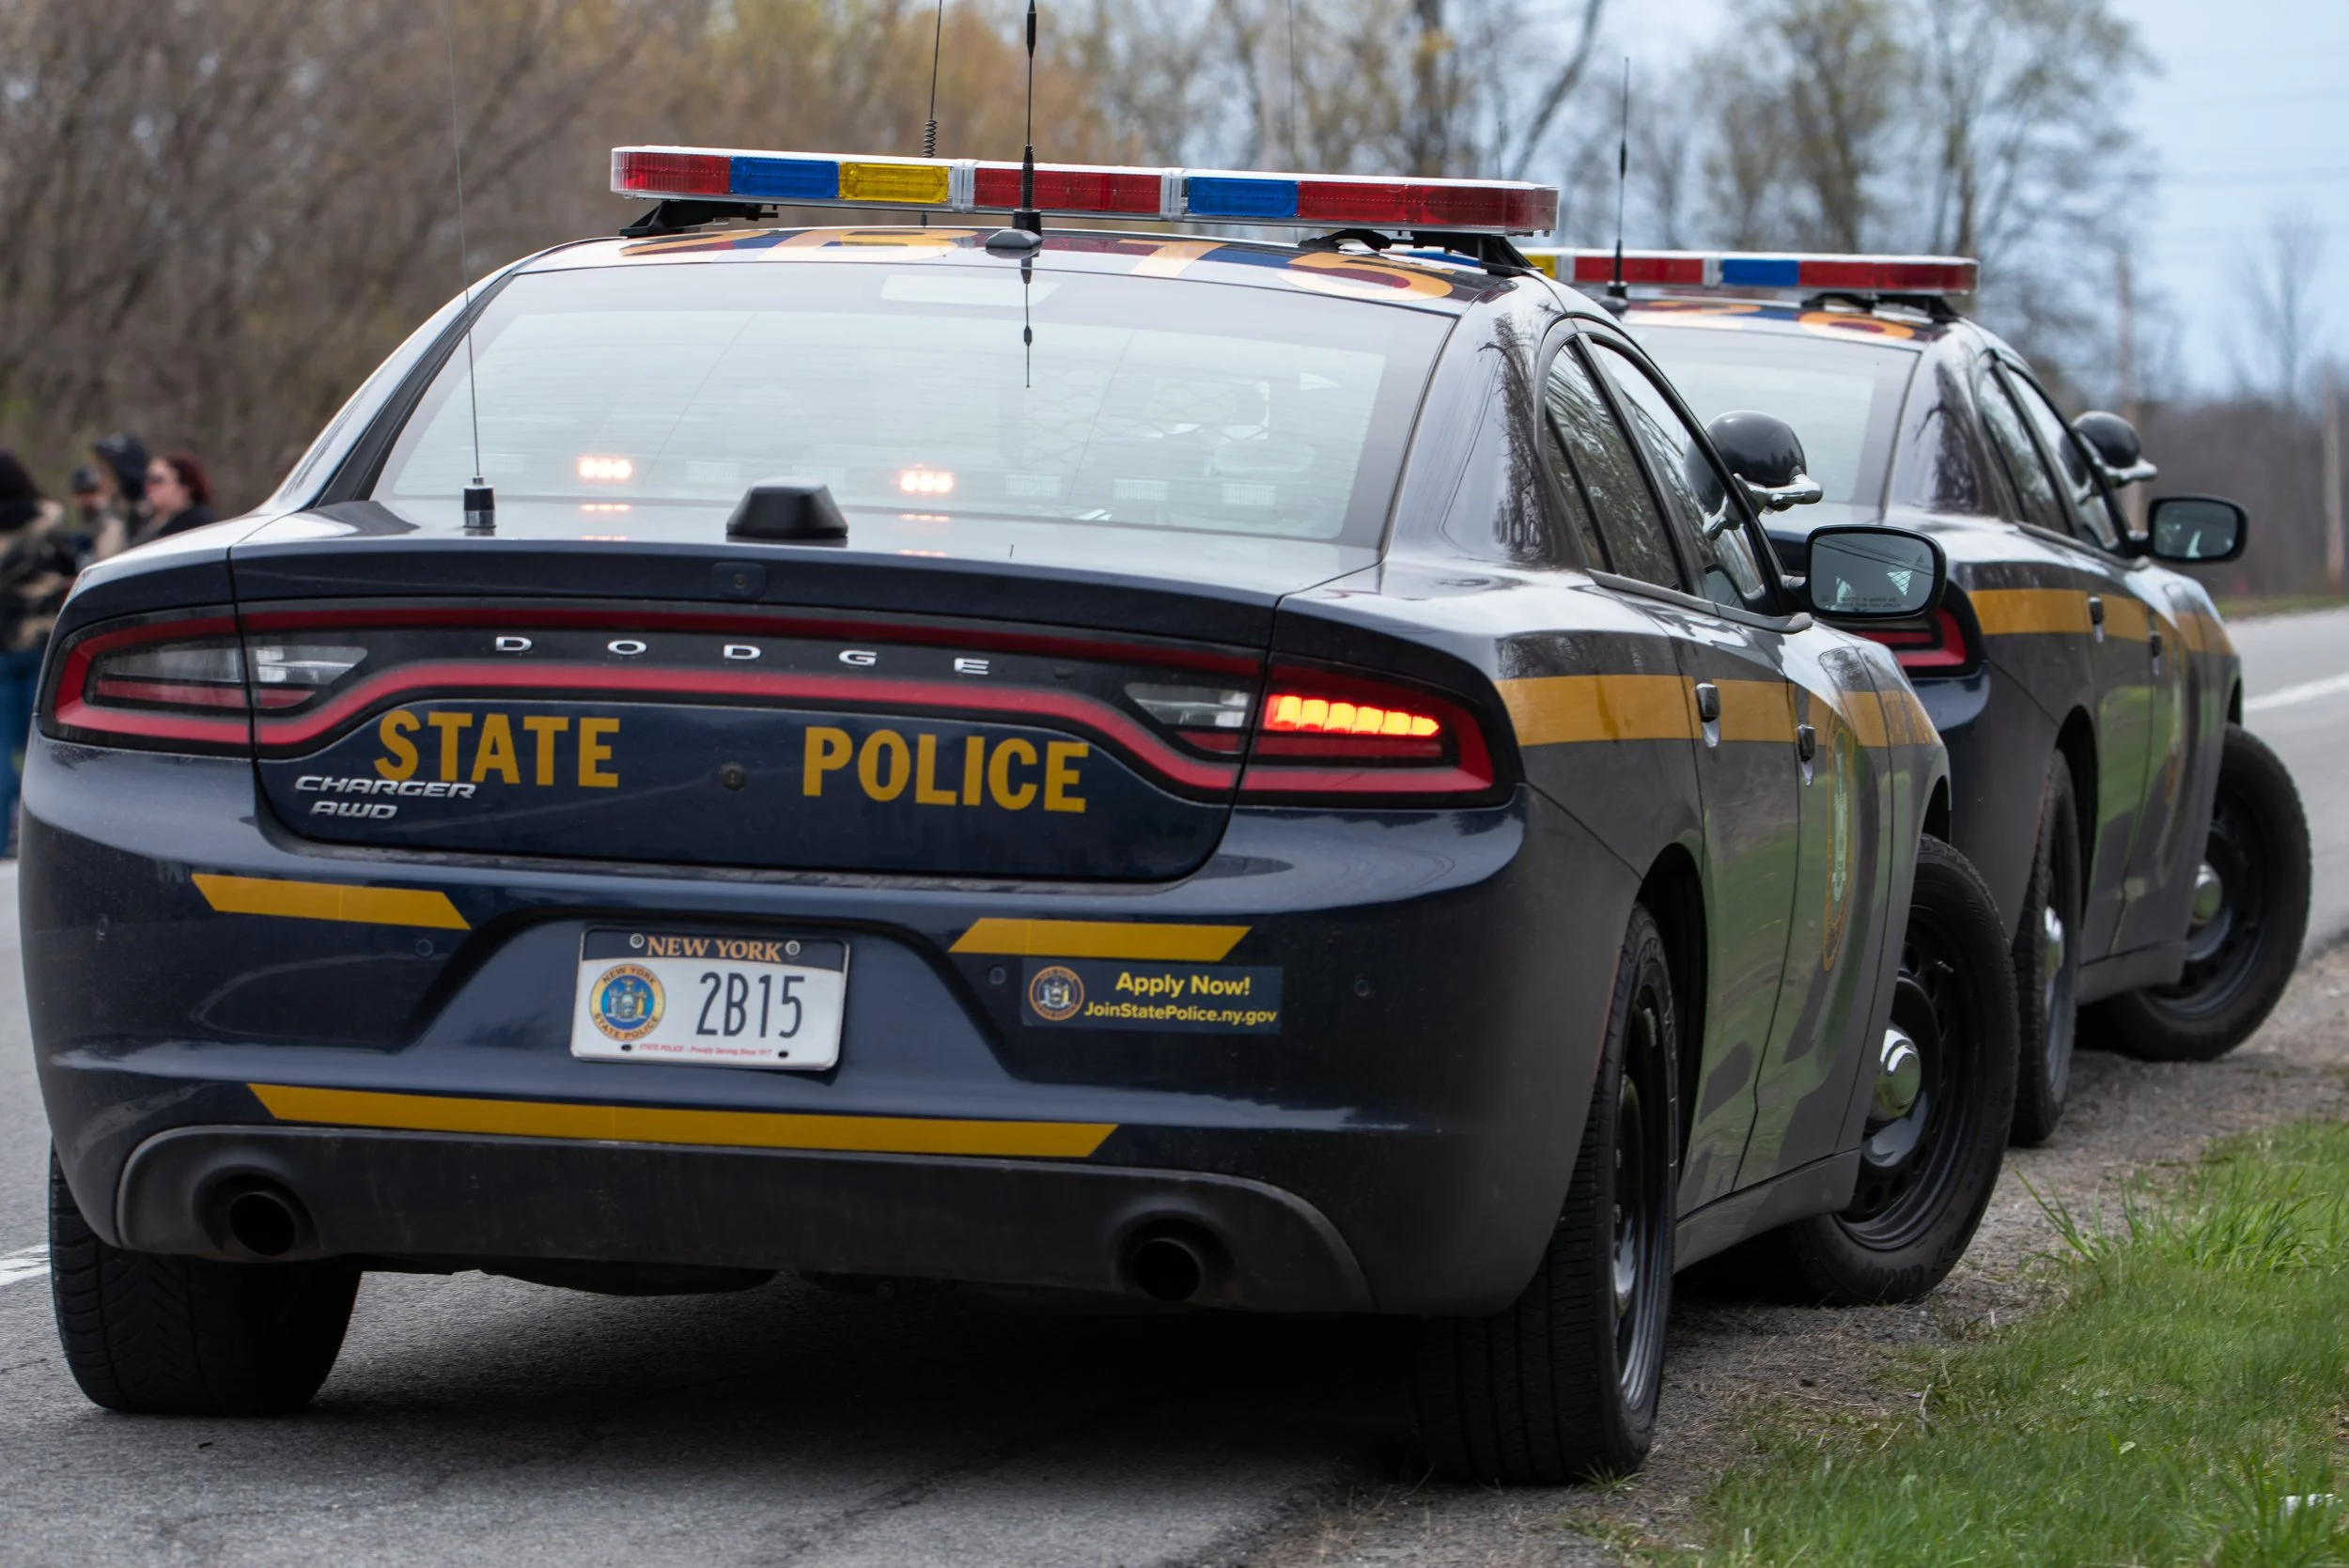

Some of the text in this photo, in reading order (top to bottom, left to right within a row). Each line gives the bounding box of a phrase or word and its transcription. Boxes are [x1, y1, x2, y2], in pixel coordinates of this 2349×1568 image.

[495, 636, 989, 675] DODGE
[374, 709, 1090, 814] STATE POLICE
[294, 775, 476, 800] CHARGER
[309, 800, 398, 820] AWD
[646, 936, 784, 963] NEW YORK
[1115, 971, 1252, 998] Apply Now!
[695, 971, 805, 1039] 2B15
[1083, 1001, 1278, 1026] JoinStatePolice.ny.gov
